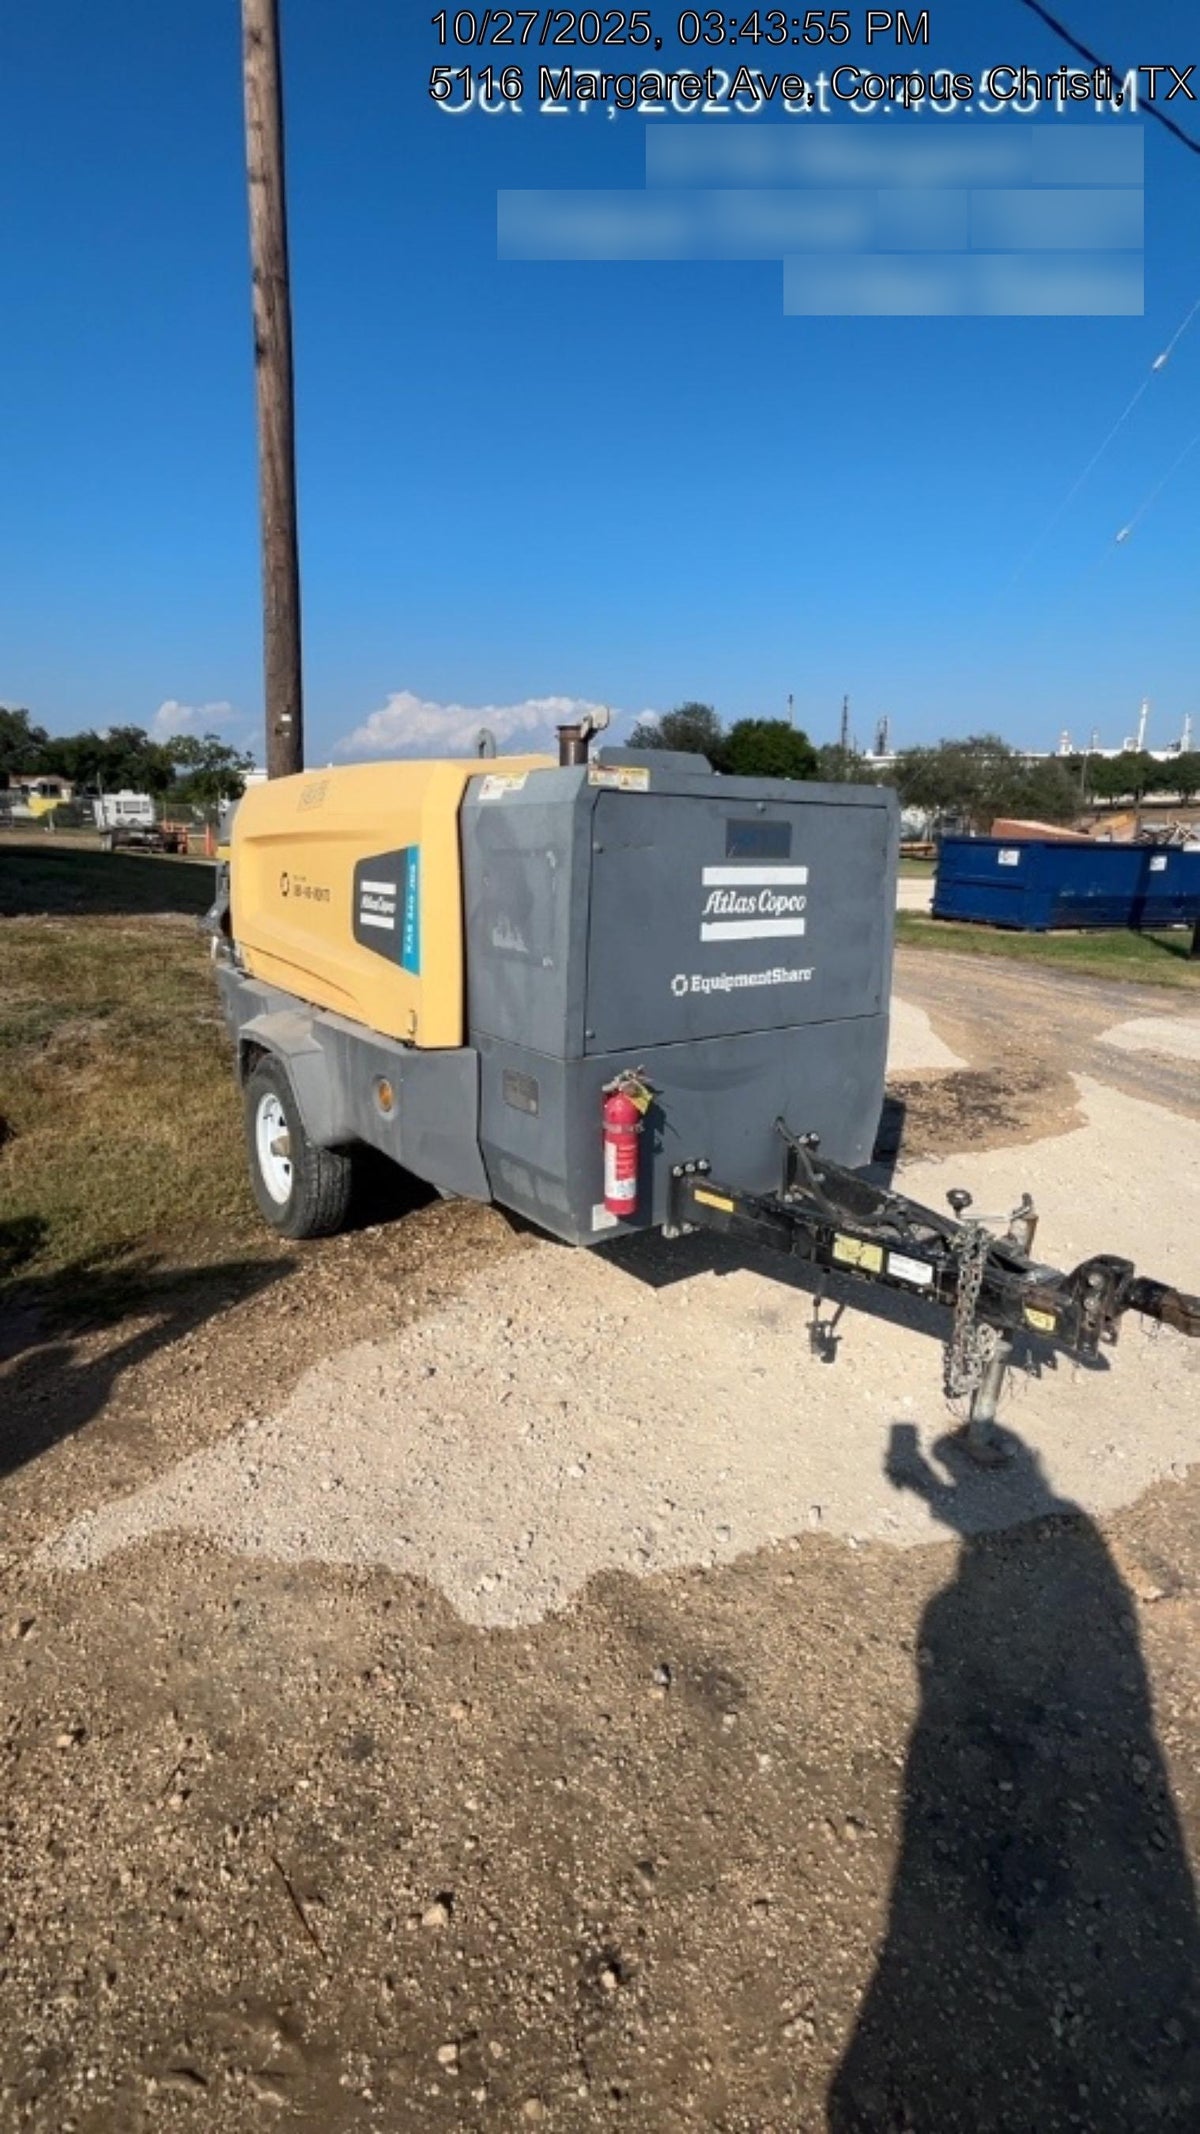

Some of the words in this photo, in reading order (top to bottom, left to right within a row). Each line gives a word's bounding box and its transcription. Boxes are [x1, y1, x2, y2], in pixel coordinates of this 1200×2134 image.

[702, 889, 757, 916] Atlas
[757, 888, 808, 916] Copco
[690, 966, 813, 995] EquipmentShare
